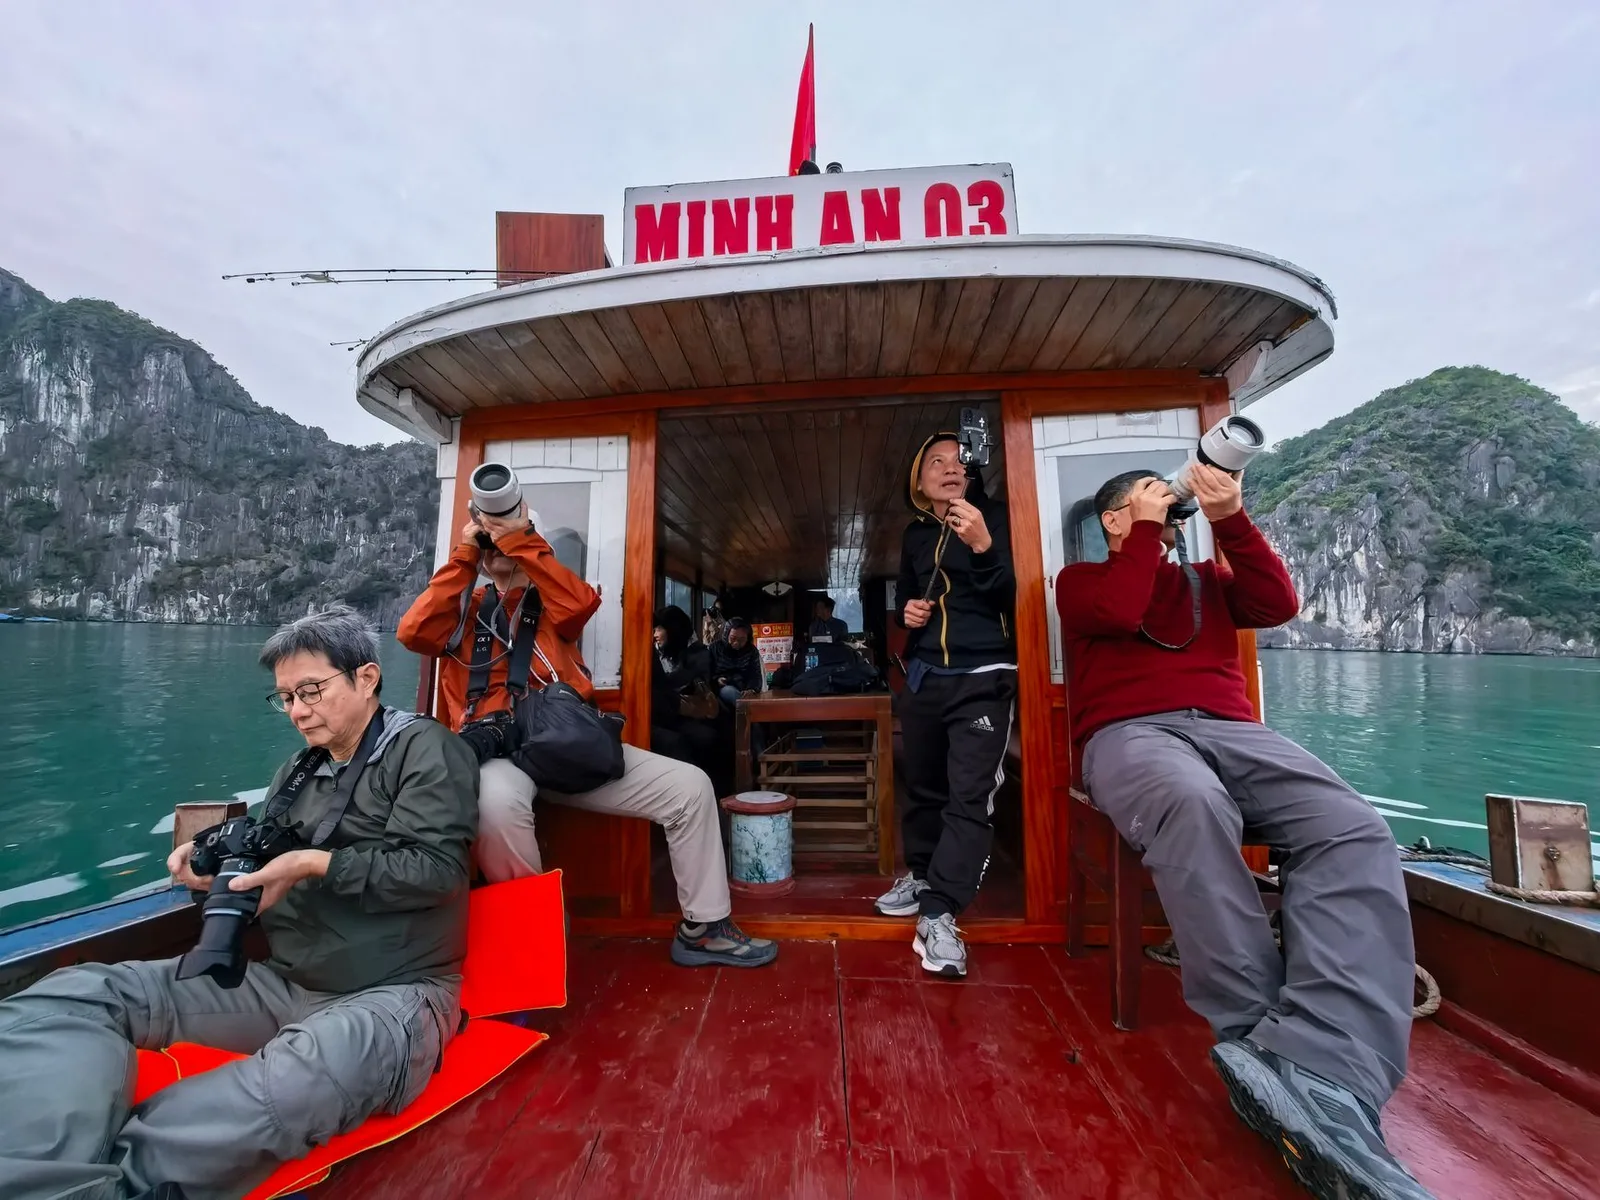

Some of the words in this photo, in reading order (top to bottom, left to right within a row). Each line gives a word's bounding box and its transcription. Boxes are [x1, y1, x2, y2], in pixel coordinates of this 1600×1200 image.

[635, 194, 793, 264] MINH
[820, 187, 900, 246] AN
[969, 723, 995, 732] adidas
[288, 771, 306, 791] OM-1
